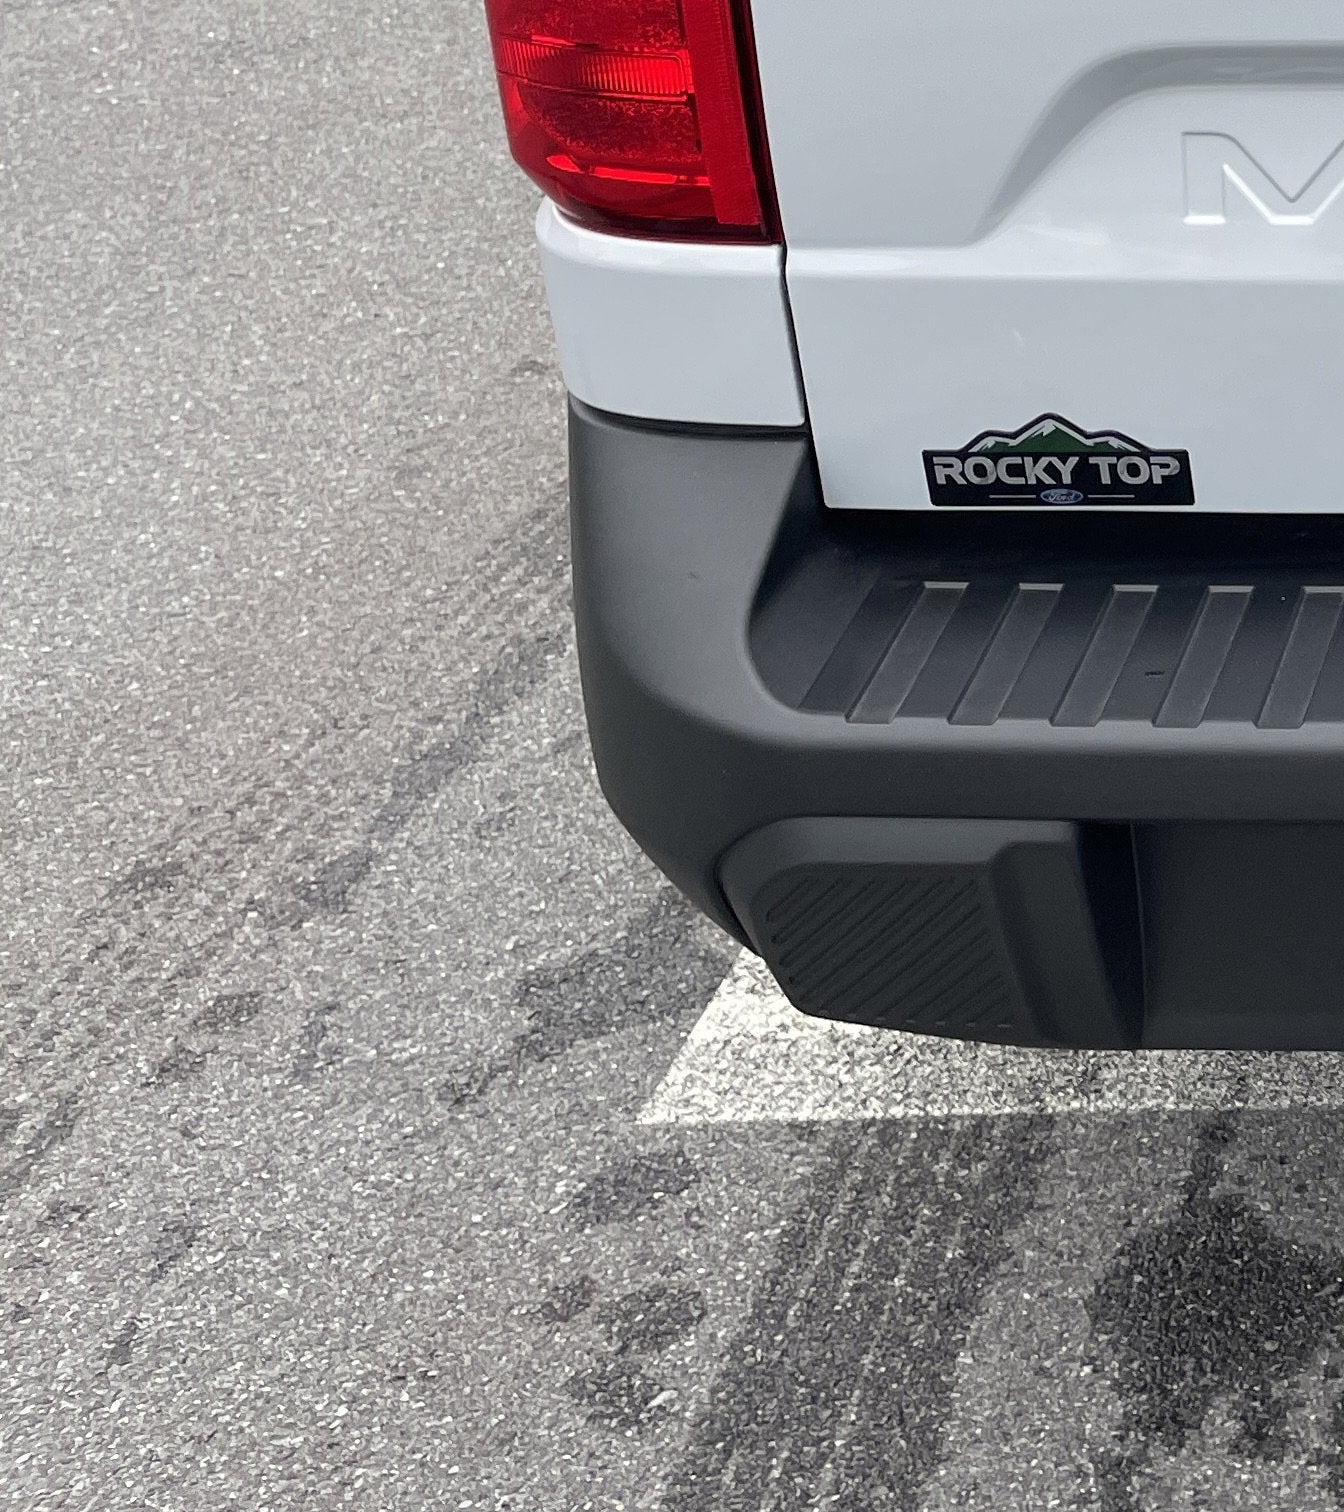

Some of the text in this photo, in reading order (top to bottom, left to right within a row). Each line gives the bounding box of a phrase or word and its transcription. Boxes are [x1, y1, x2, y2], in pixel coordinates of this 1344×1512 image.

[932, 455, 1181, 485] ROCKY TOP
[1047, 489, 1076, 502] Ford
